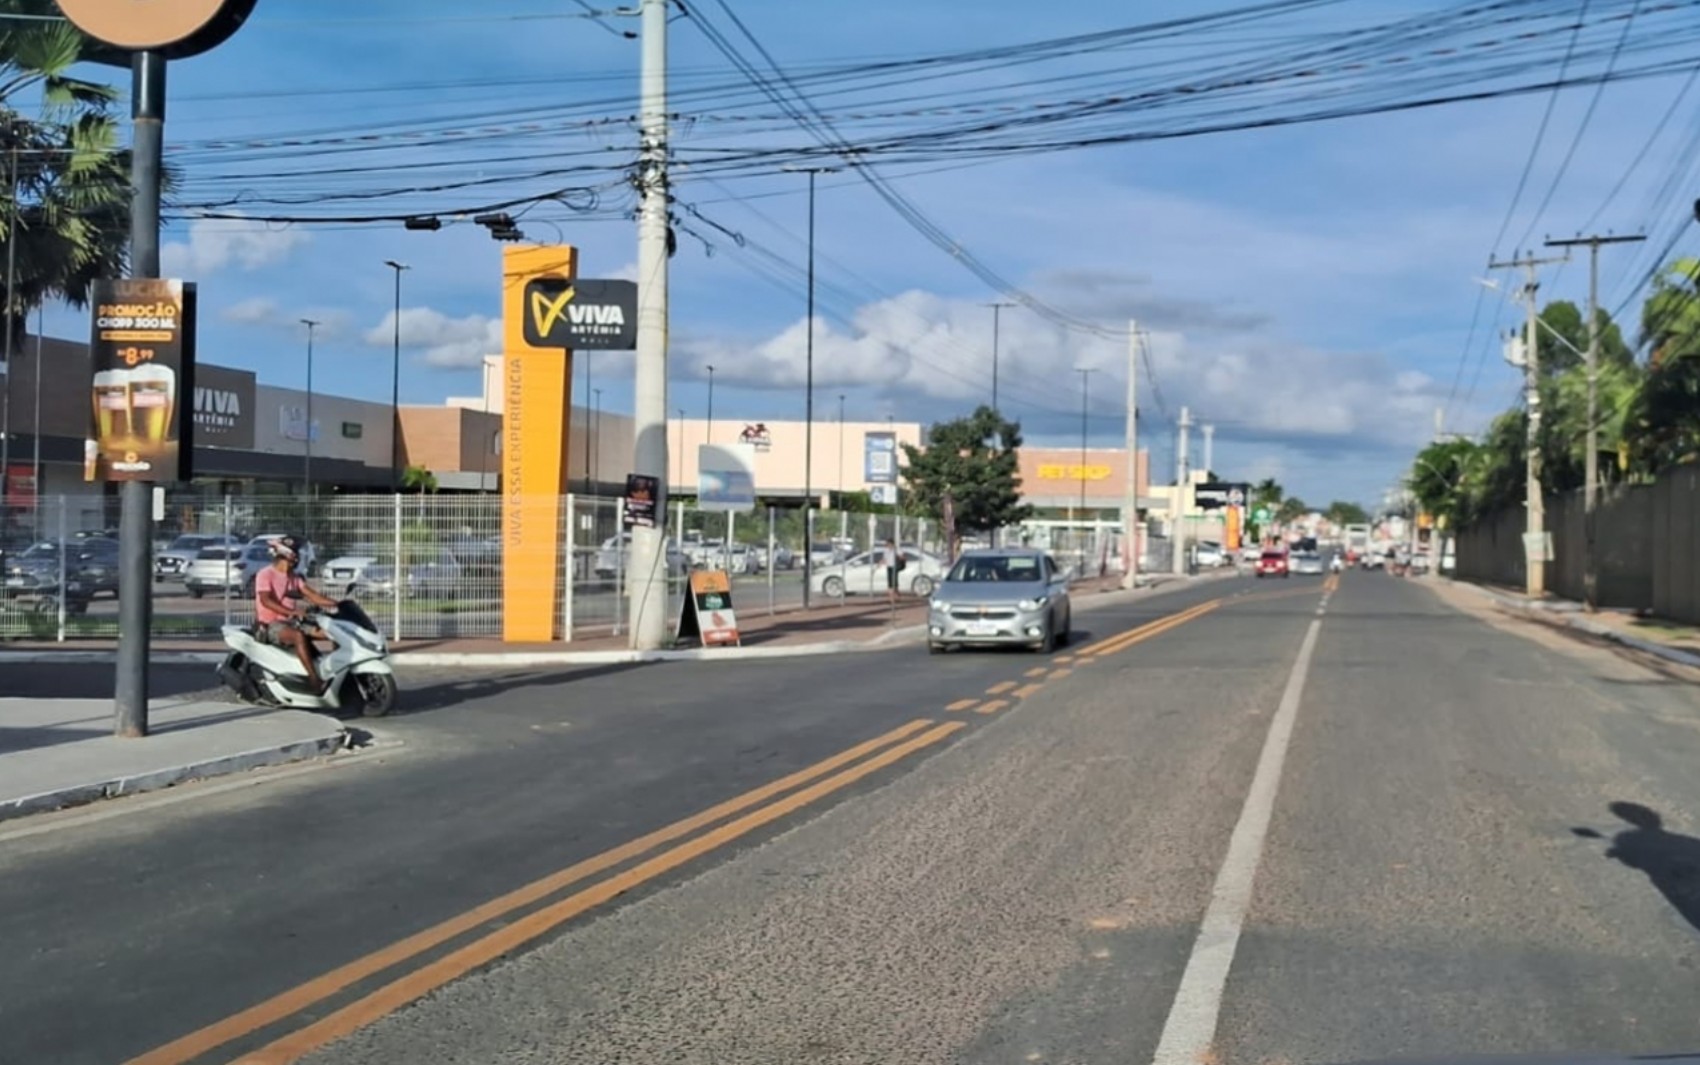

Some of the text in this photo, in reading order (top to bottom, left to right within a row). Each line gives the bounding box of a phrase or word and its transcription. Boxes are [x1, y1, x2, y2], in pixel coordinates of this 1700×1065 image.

[98, 302, 176, 317] PROMOÇÃO
[567, 304, 625, 325] VIVA
[509, 357, 522, 547] VIVA ESSA EXPERIÊNCIA
